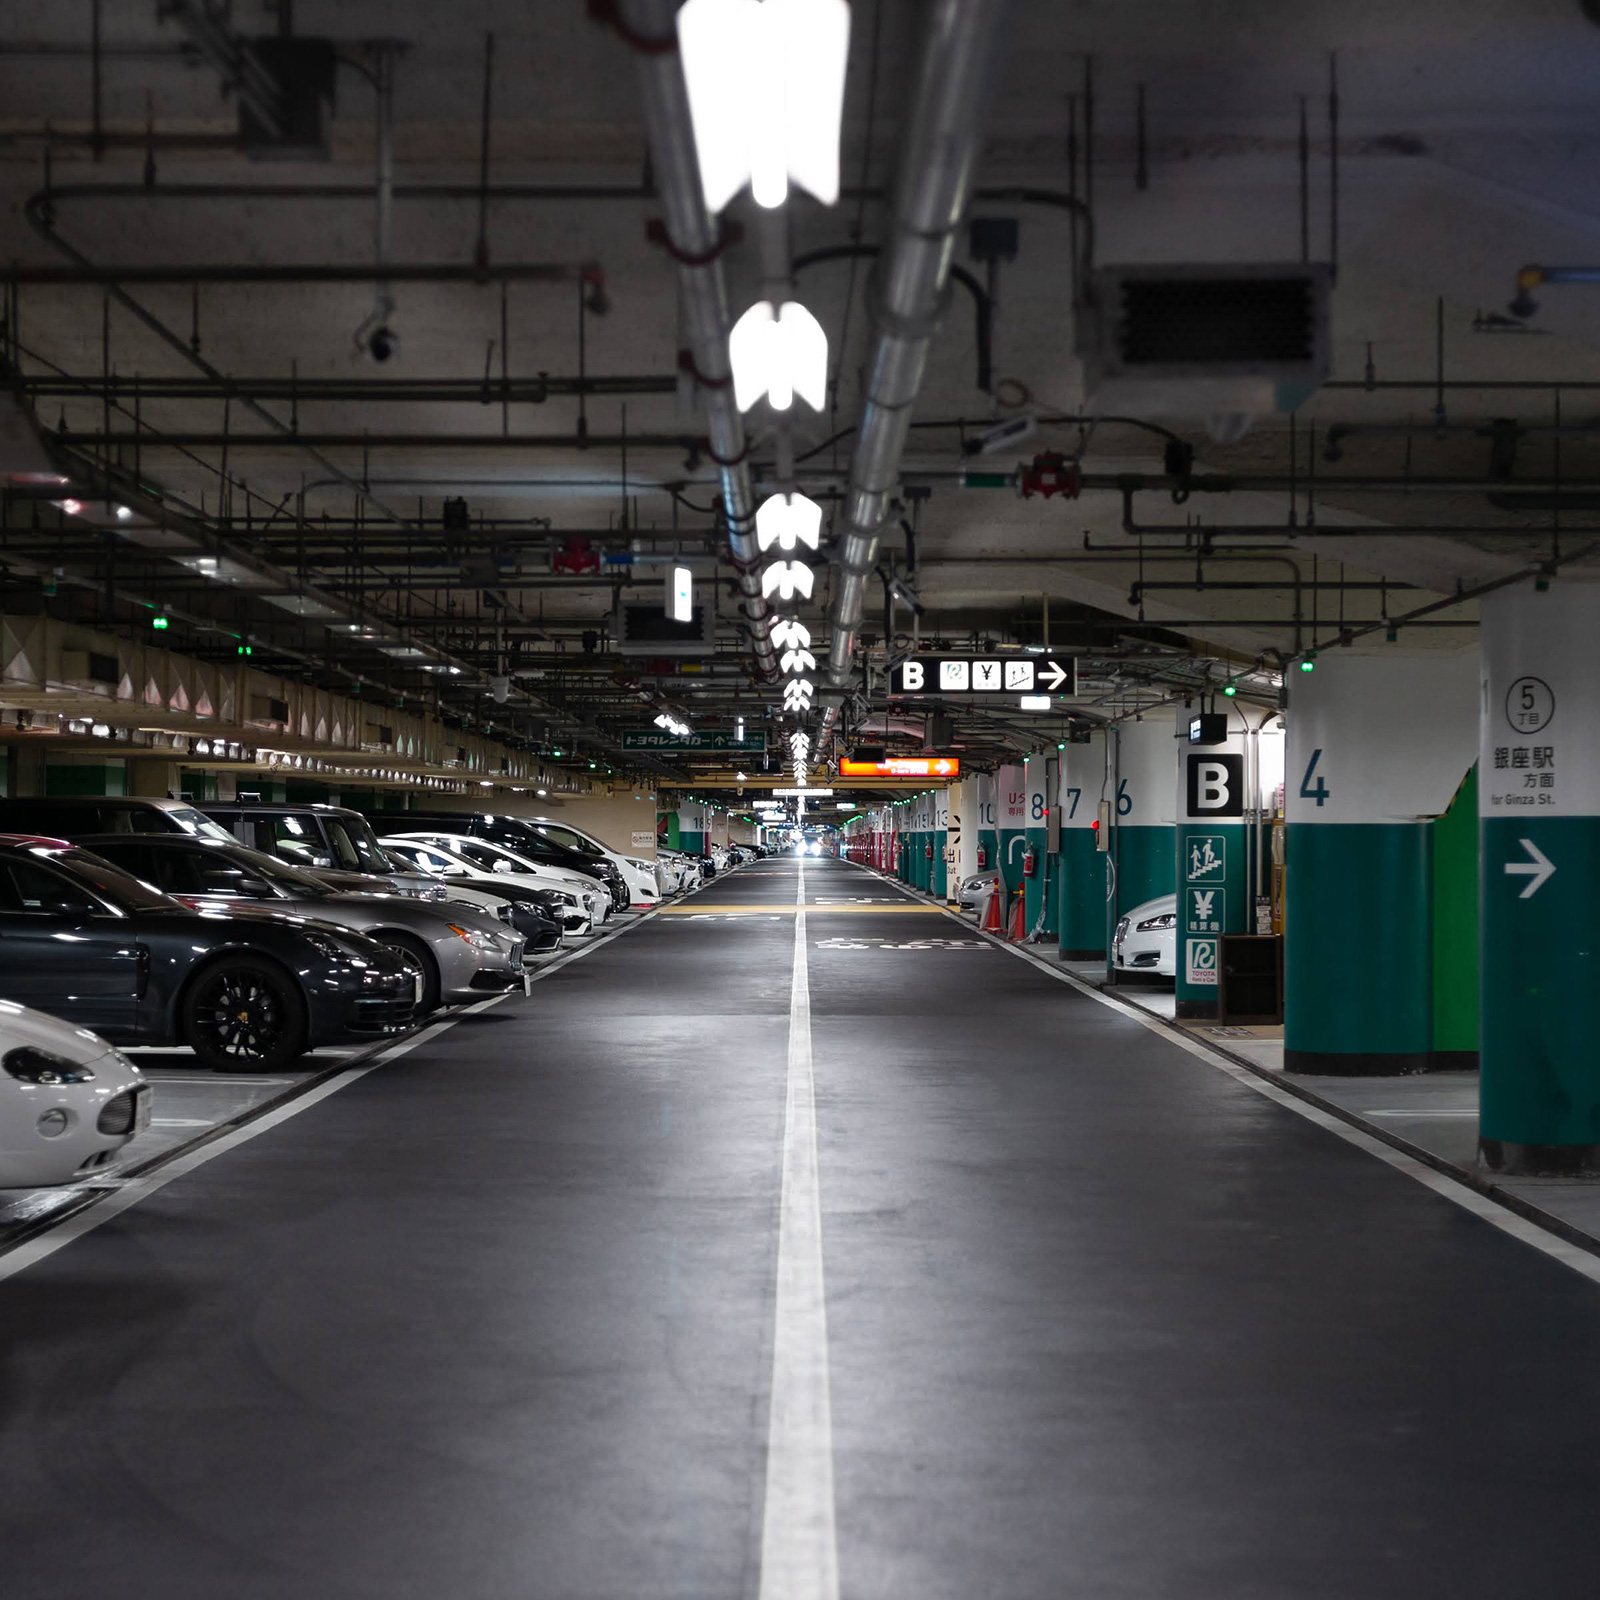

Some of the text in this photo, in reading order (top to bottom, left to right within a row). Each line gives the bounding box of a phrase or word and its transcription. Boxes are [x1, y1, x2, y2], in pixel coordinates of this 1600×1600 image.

[903, 661, 925, 690] B
[1521, 685, 1535, 710] 5
[1518, 713, 1540, 725] 丁目
[626, 735, 711, 745] トヨタレンタカー
[1494, 746, 1555, 769] 銀座駅
[1197, 762, 1230, 809] B
[1300, 749, 1330, 807] 4
[1523, 773, 1555, 788] 方面
[1031, 793, 1044, 820] 8
[1067, 788, 1081, 819] 7
[1117, 779, 1132, 816] 6
[1505, 794, 1535, 805] Ginza
[1538, 793, 1556, 805] St.
